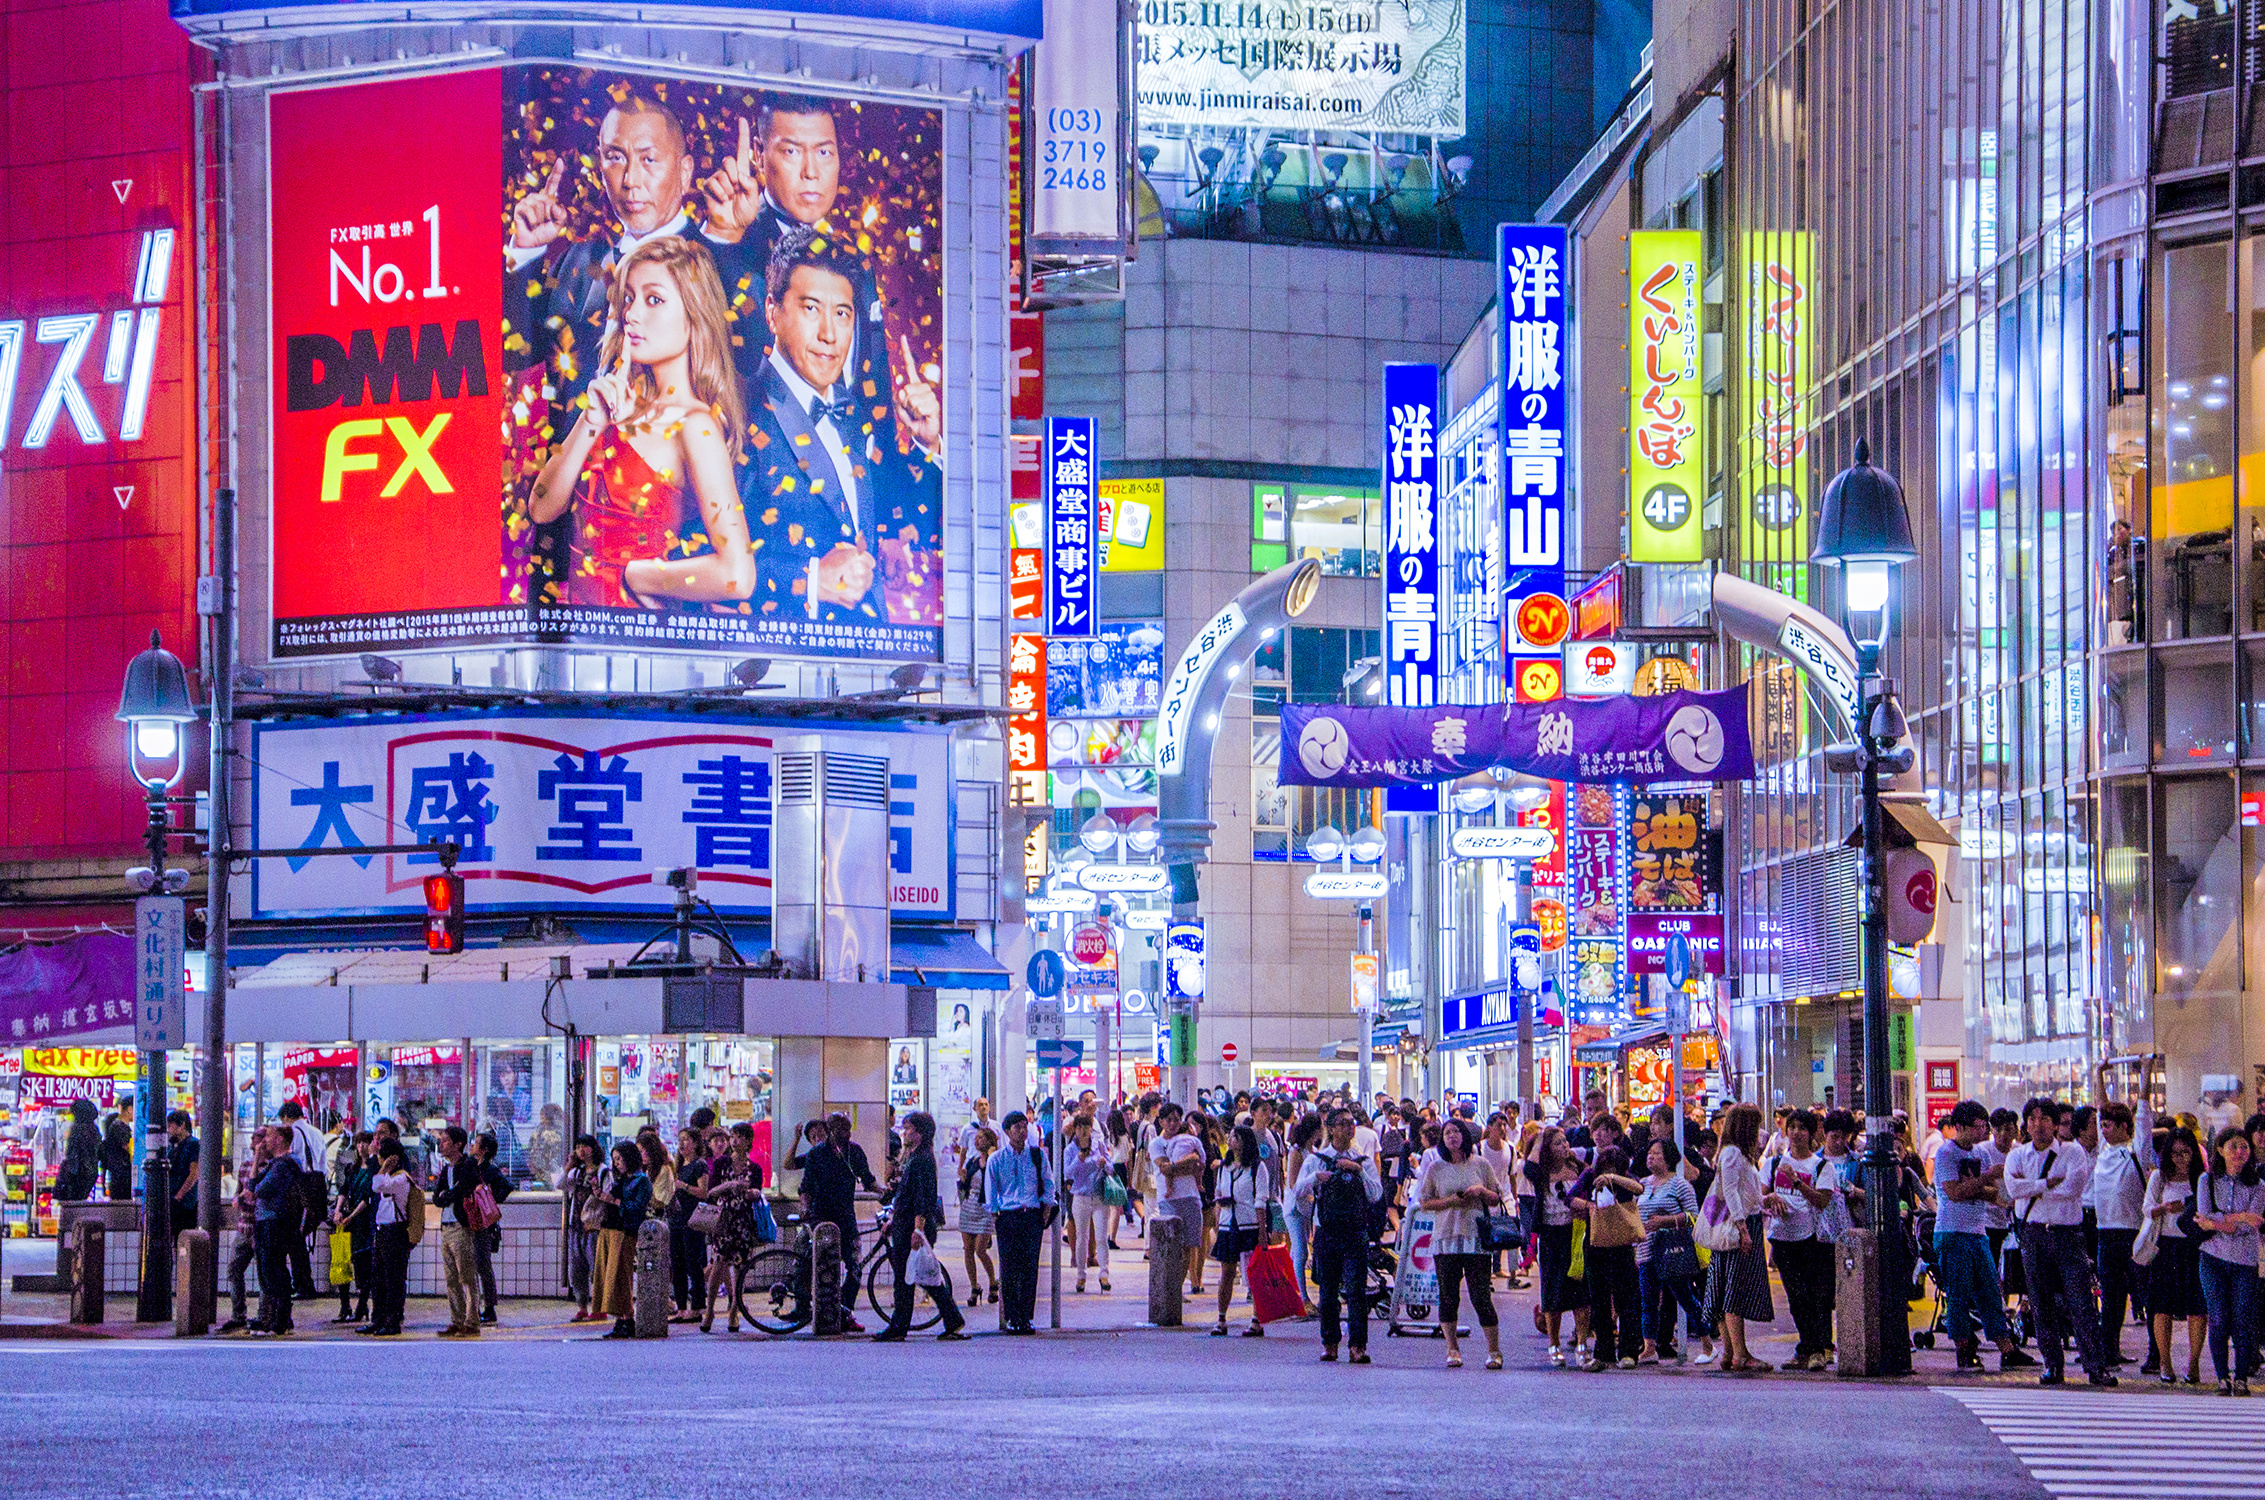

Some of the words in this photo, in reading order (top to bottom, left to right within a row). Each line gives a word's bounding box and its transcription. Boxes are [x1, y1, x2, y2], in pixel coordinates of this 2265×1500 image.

[1138, 88, 1363, 113] www.jinmiraisai.com
[1048, 107, 1102, 134] (03)
[1044, 140, 1106, 163] 3719
[1043, 167, 1106, 190] 2468
[389, 220, 414, 238] 世界
[1682, 262, 1696, 380] ステーキ&ハンバーグ
[287, 319, 489, 411] DMM
[1637, 263, 1693, 469] くいしんぼ
[1506, 245, 1563, 566] 洋服の青山
[321, 412, 455, 502] FX
[1644, 489, 1688, 523] 4F
[1055, 428, 1088, 627] 大盛堂商事ビル
[1387, 404, 1437, 704] 洋服の青山
[1135, 660, 1159, 675] 4F
[1159, 613, 1233, 769] 渋谷センター街
[1348, 758, 1434, 775] 金王八幡宮大祭
[1631, 799, 1698, 852] 油
[1457, 835, 1549, 849] 渋谷センター街
[1574, 834, 1596, 908] ハンバーグ
[1594, 832, 1615, 907] ステーキ&
[1632, 850, 1700, 880] そば
[890, 885, 939, 904] ISEIDO
[1310, 879, 1385, 891] 渋谷センター街
[1657, 920, 1691, 932] CLUB
[1075, 939, 1105, 954] 消火栓
[1631, 936, 1720, 951] GASNIC
[144, 908, 165, 1025] 文化村通り
[1481, 990, 1511, 1026] AOYAMA
[1030, 1026, 1038, 1035] 12
[79, 1049, 136, 1068] Free
[239, 1055, 282, 1072] Saari
[284, 1051, 315, 1069] PAPER
[1136, 1068, 1152, 1076] TAX
[1137, 1076, 1155, 1085] FREE
